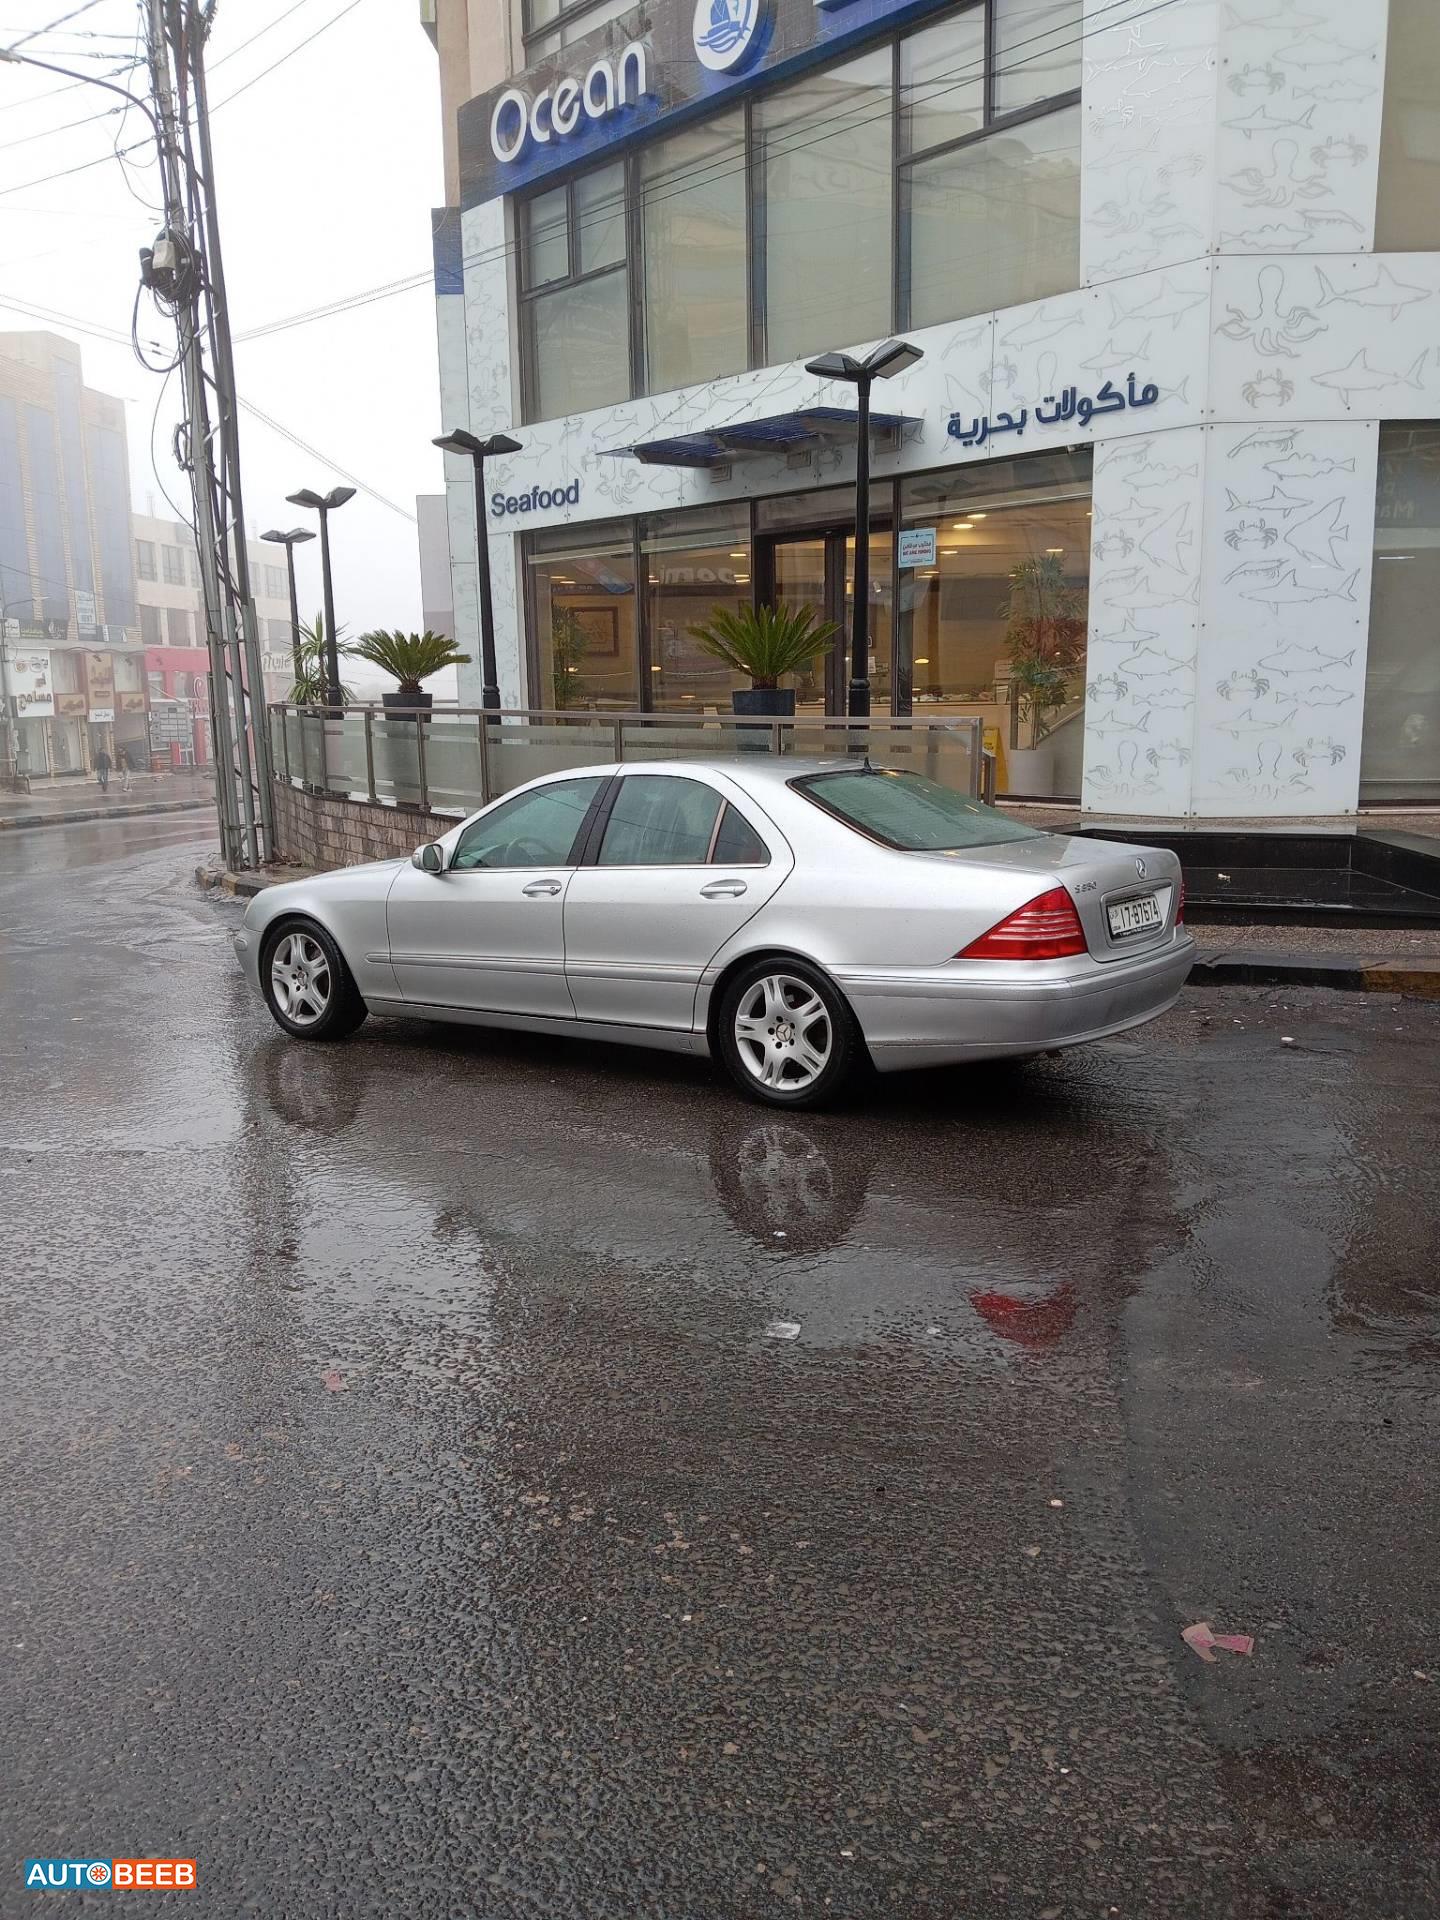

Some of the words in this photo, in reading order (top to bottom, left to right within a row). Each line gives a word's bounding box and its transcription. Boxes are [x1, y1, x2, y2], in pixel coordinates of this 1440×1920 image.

[490, 41, 647, 163] Ocean
[1035, 372, 1159, 427] مأكولات
[947, 408, 1028, 446] بحرية
[491, 478, 579, 517] Seafood
